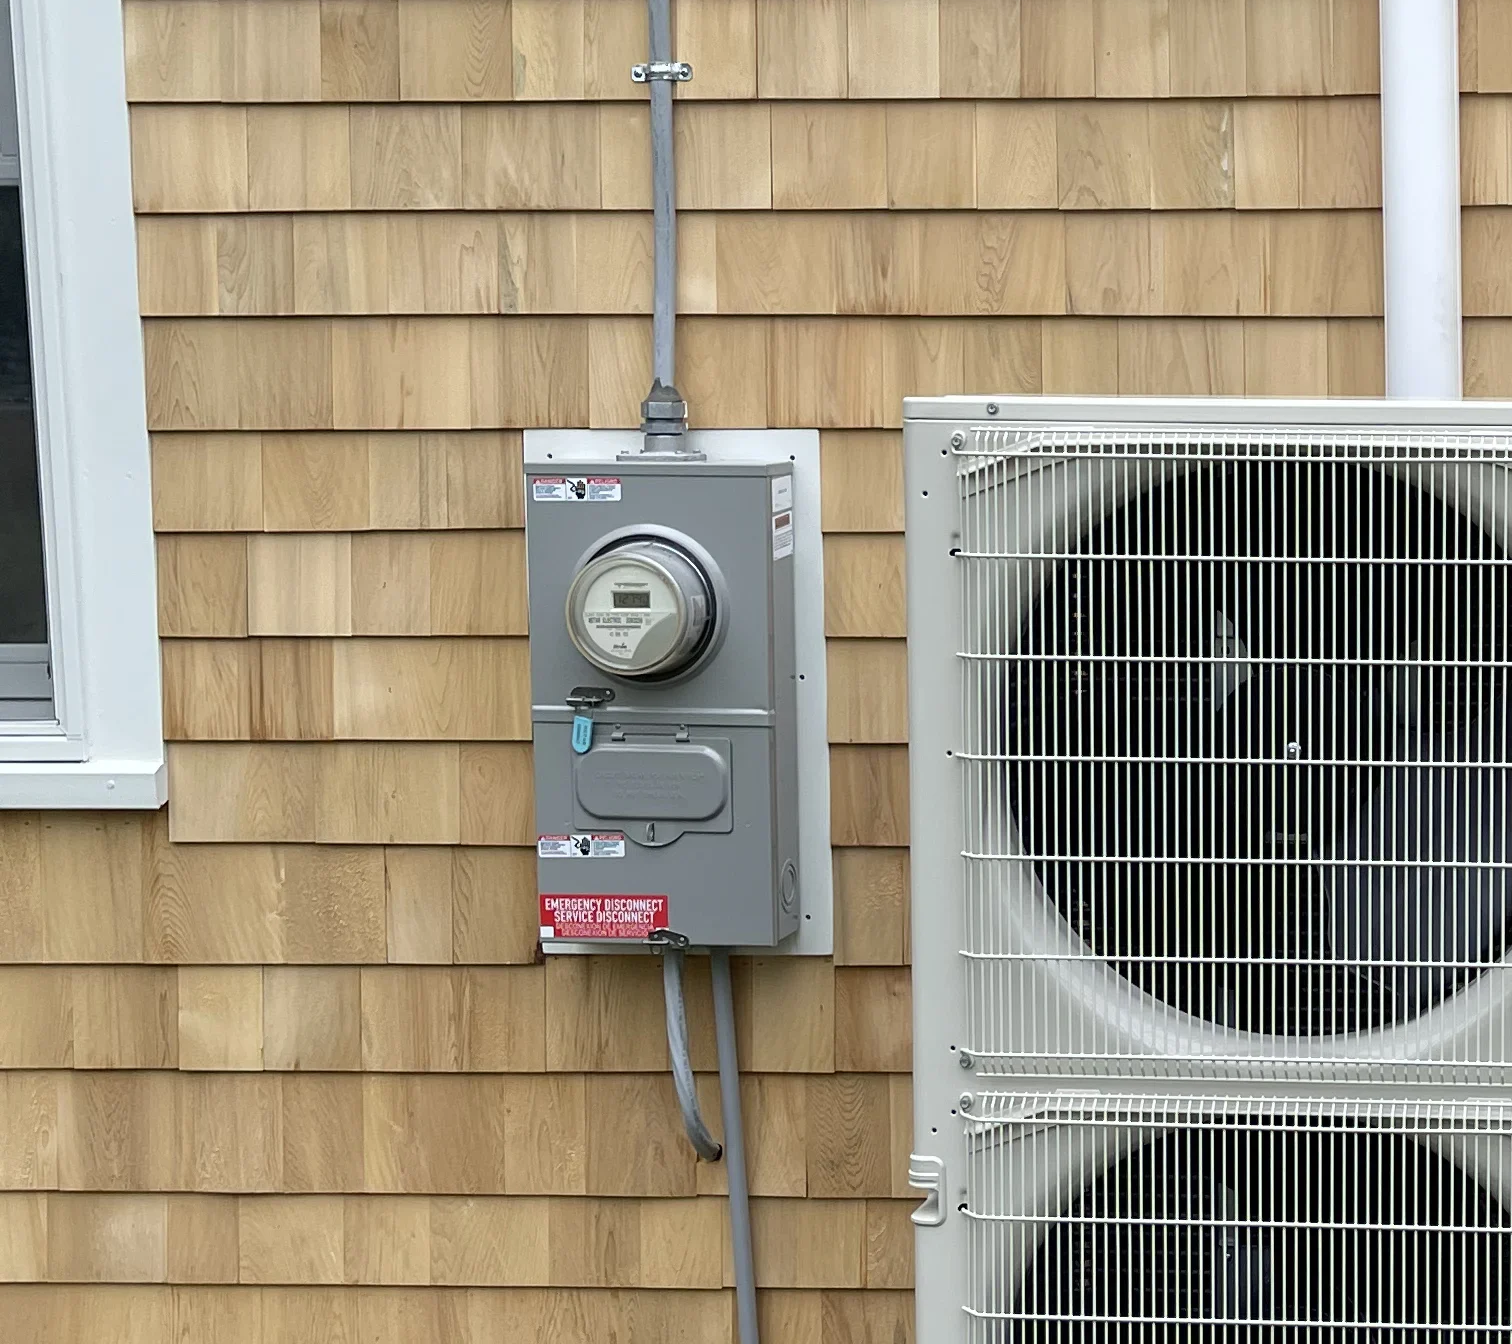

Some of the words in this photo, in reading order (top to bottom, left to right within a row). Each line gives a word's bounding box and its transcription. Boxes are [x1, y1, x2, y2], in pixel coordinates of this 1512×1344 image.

[545, 898, 602, 911] EMERGENCY
[604, 899, 663, 912] DISCONNECT
[554, 911, 593, 923] SERVICE
[596, 911, 655, 923] DISCONNECT
